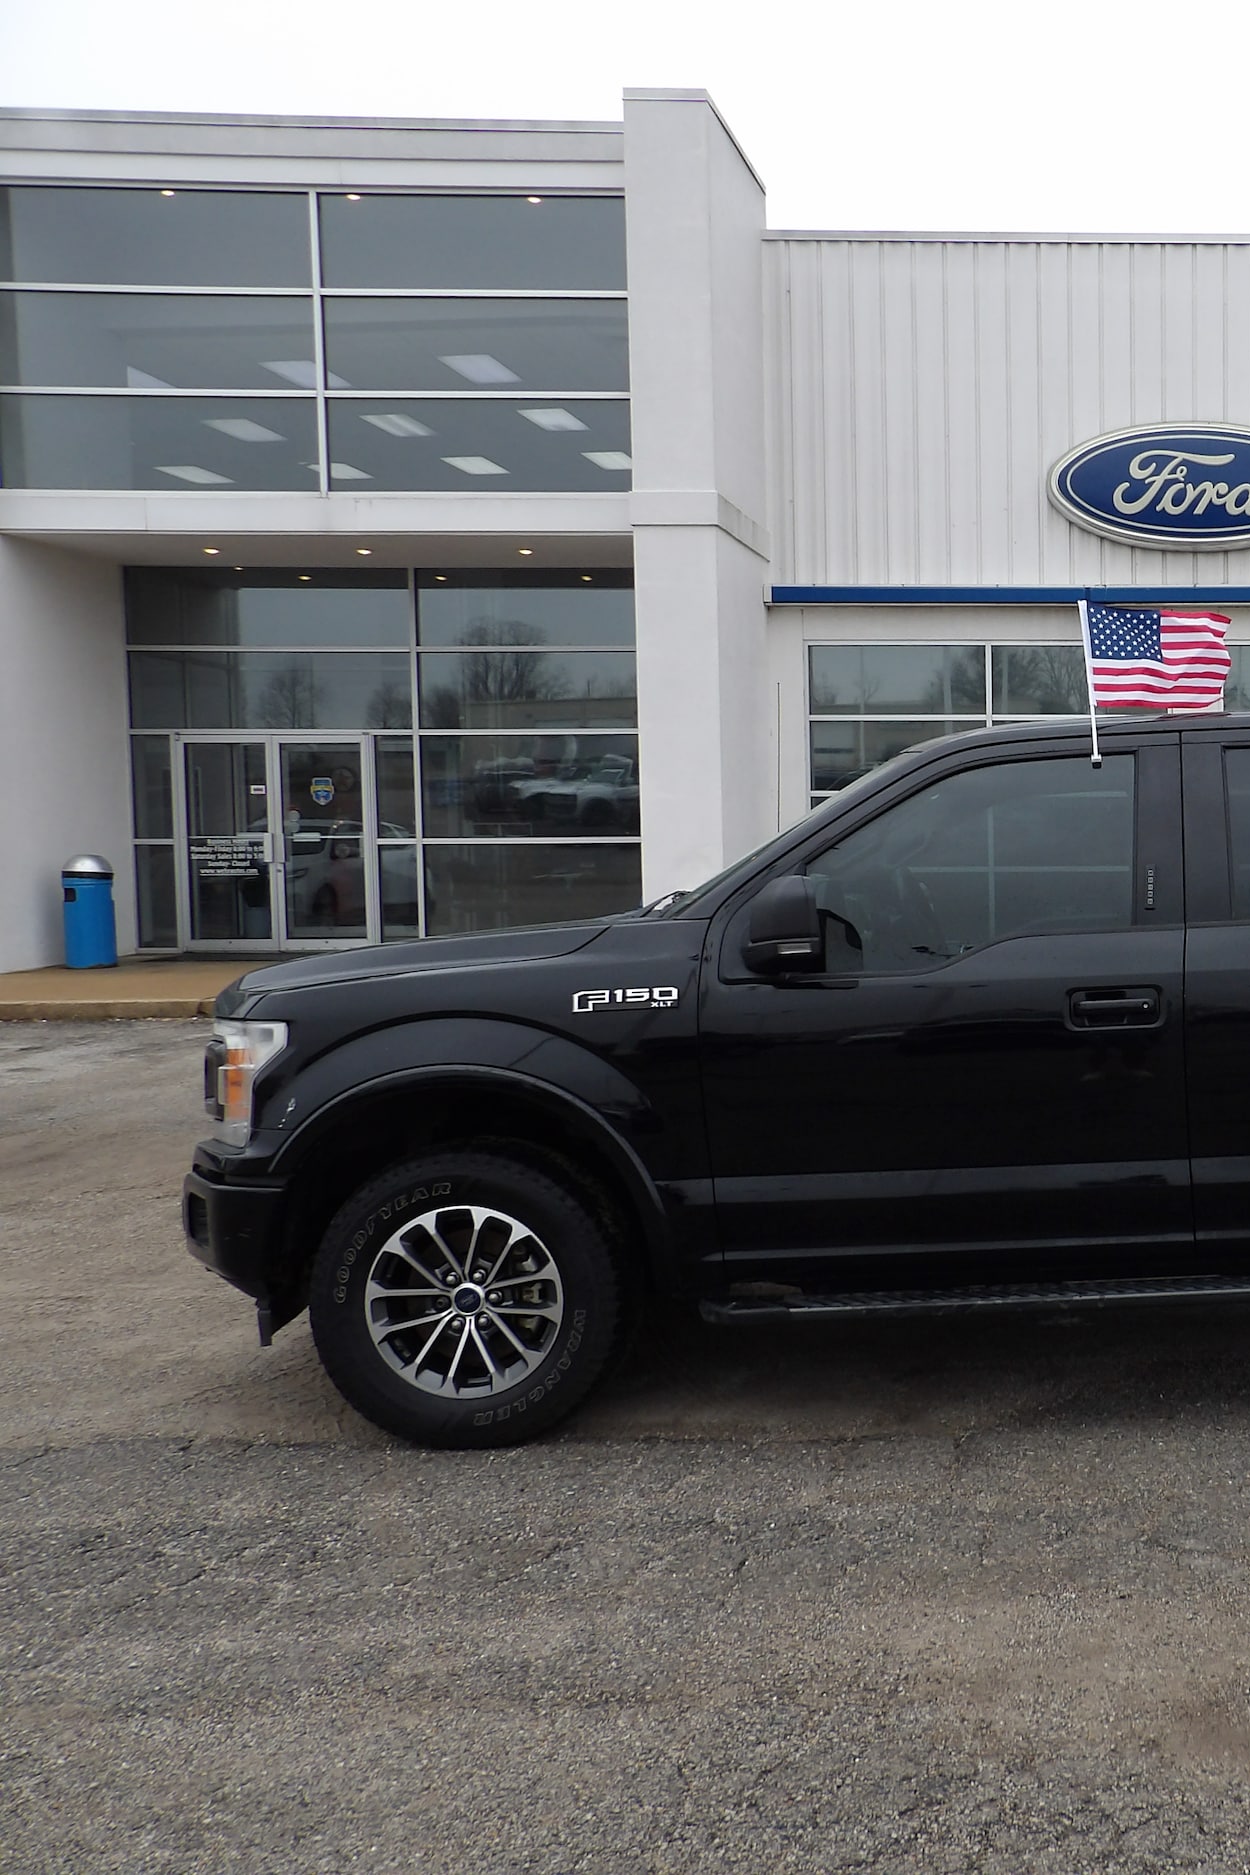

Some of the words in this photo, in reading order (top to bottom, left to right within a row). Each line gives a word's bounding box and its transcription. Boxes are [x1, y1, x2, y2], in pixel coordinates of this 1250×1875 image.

[650, 1000, 675, 1008] XLT
[333, 1181, 452, 1305] GOODYEAR
[473, 1308, 587, 1427] WRANGLER
